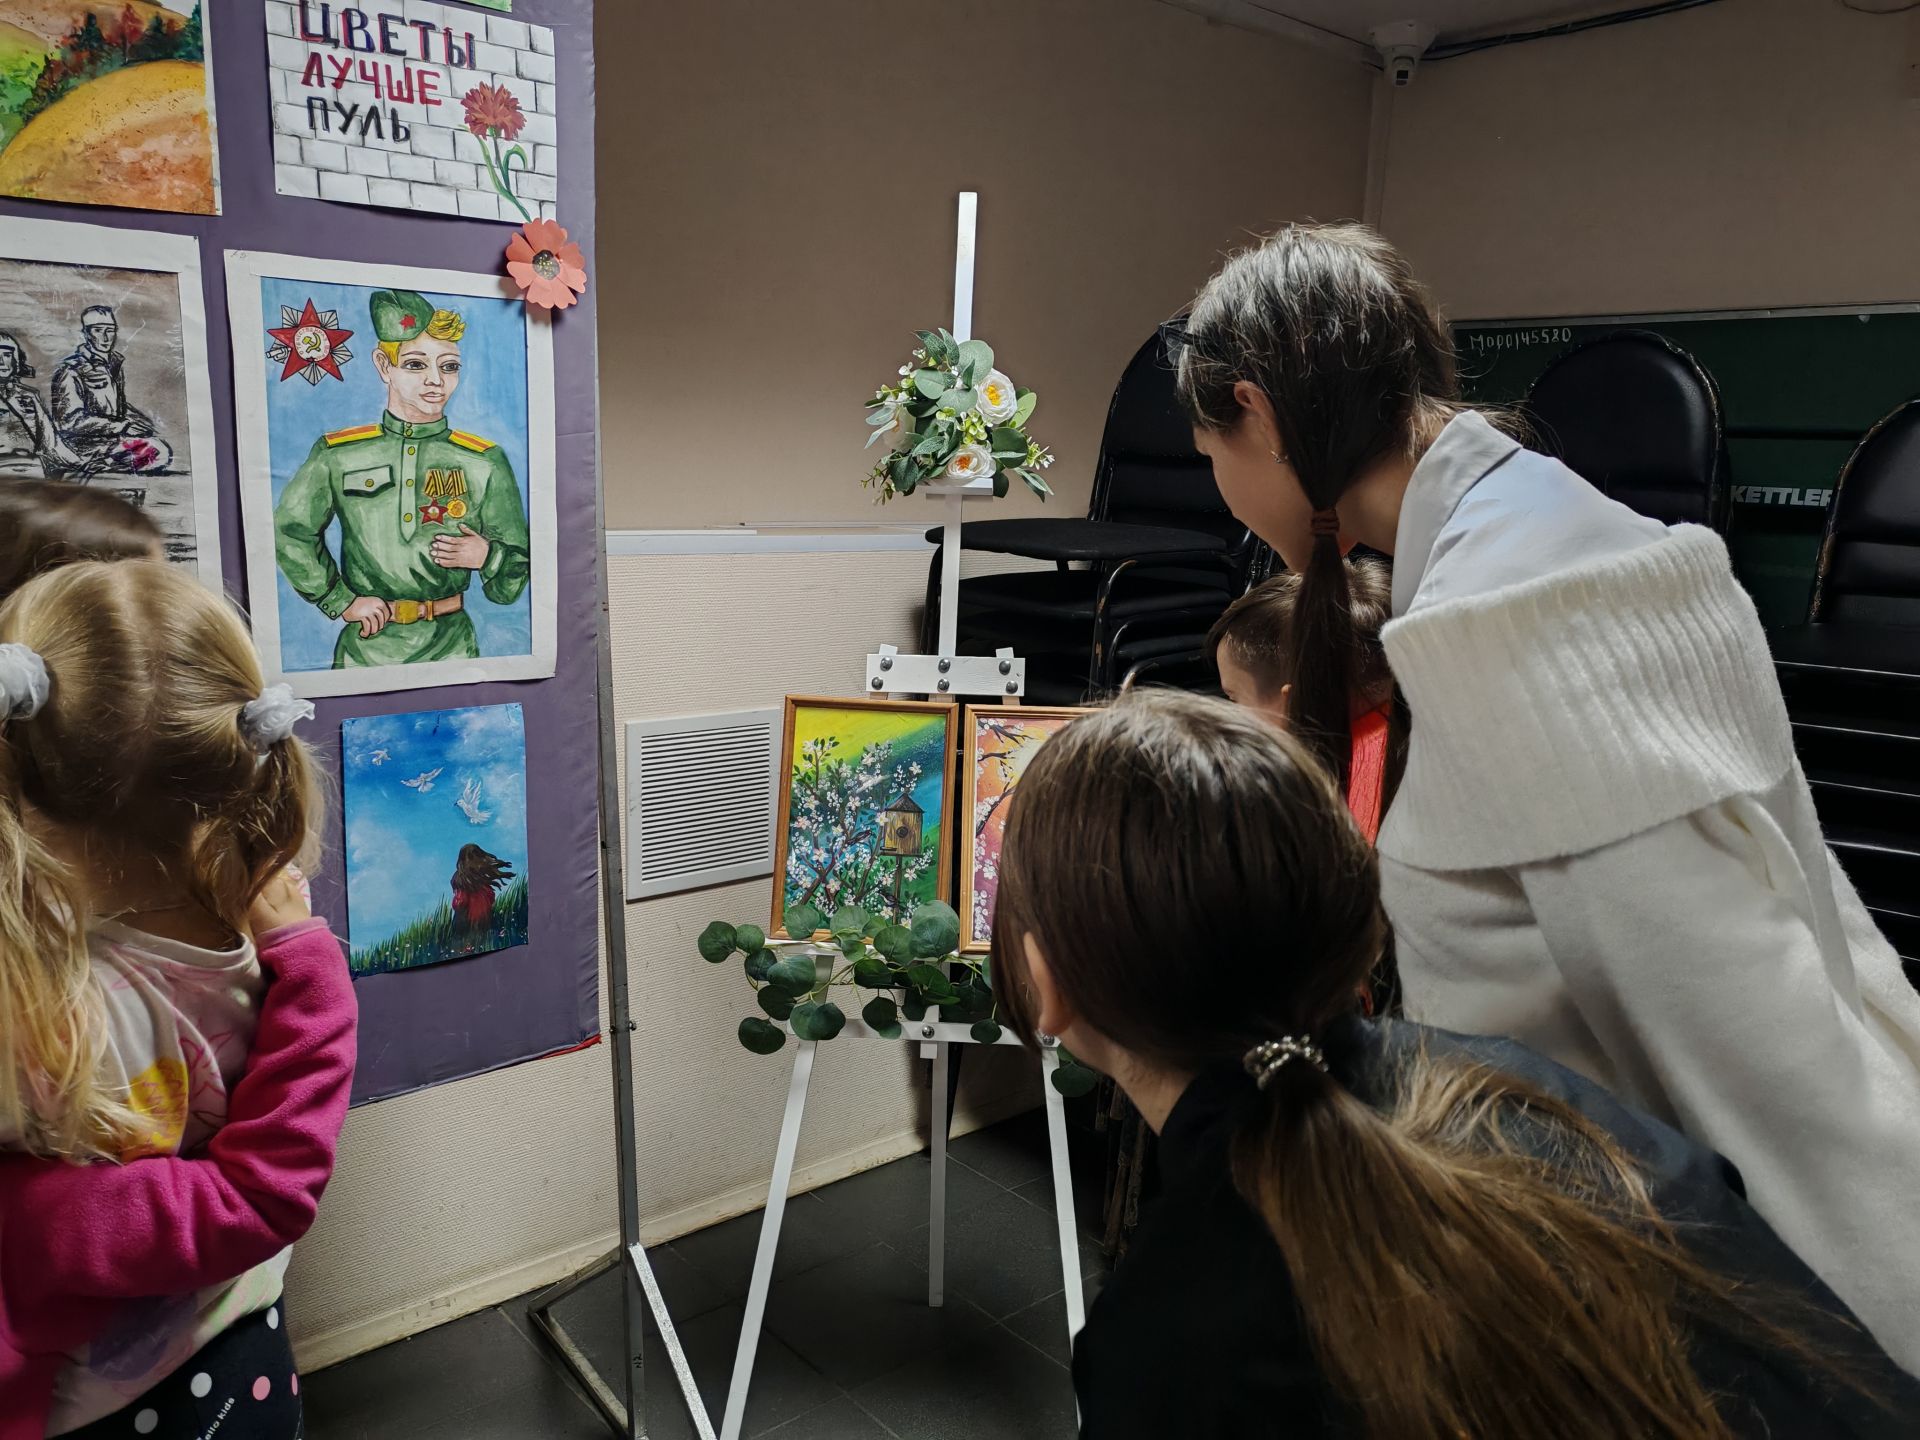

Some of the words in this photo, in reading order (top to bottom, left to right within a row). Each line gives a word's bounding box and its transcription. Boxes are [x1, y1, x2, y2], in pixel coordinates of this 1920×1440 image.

[300, 1, 476, 70] ЦВЕТЫ
[301, 52, 442, 105] ЛУЧШЕ
[307, 96, 411, 143] ПУЛЬ
[217, 1397, 235, 1420] kids
